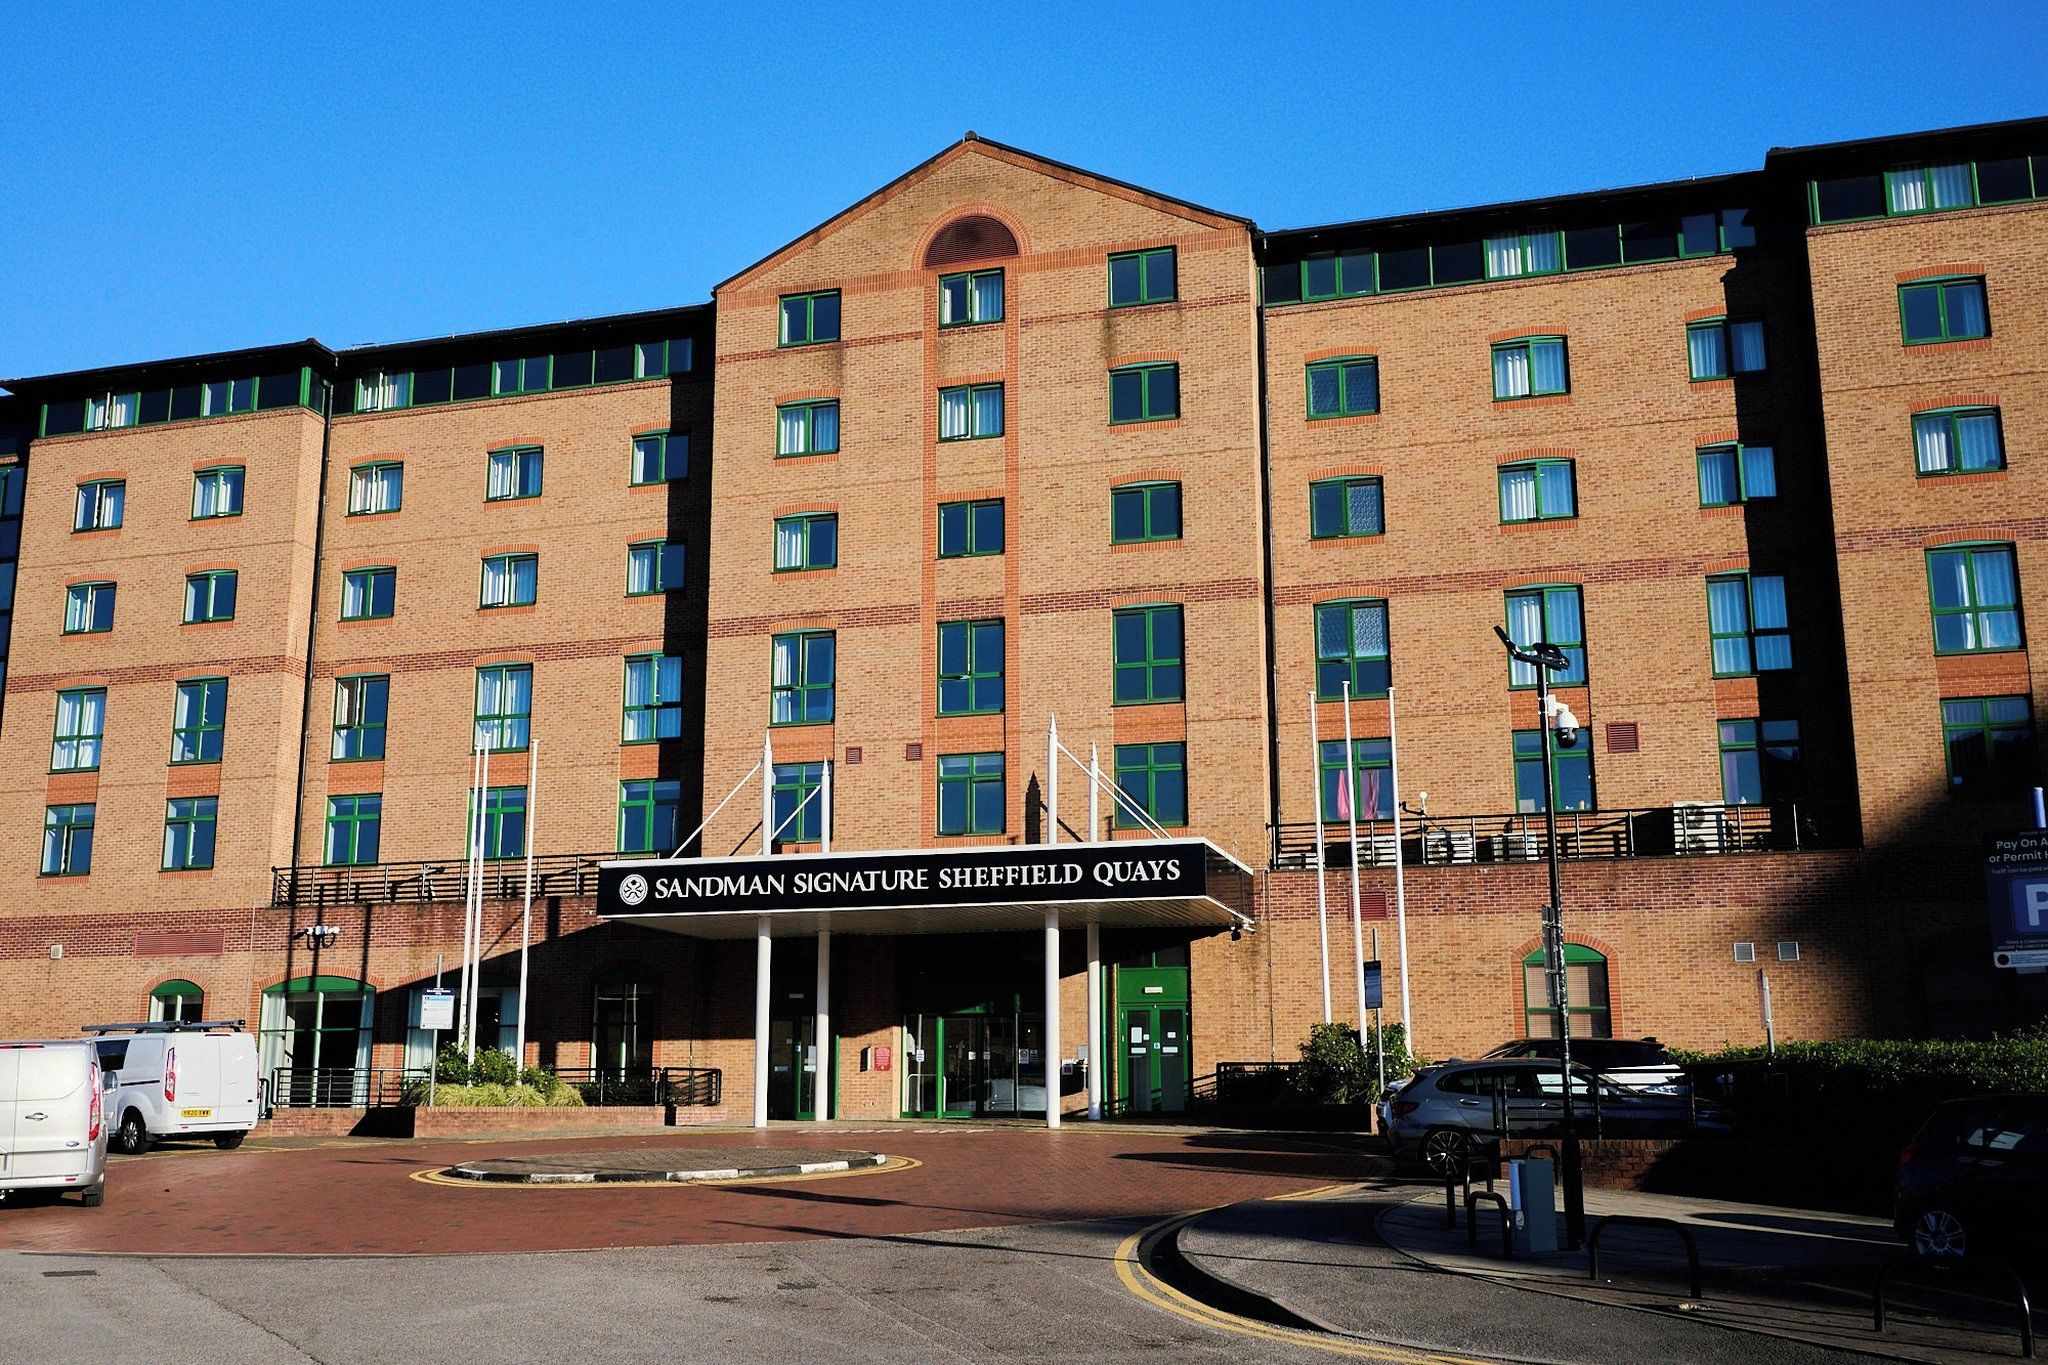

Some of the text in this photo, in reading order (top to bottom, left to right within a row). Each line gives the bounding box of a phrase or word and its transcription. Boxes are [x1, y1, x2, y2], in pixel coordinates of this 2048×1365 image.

[1996, 840, 2018, 851] Pay
[2020, 838, 2038, 848] On
[1989, 855, 2001, 863] or
[2003, 850, 2042, 862] Permit
[655, 859, 1181, 899] SANDMAN SIGNATURE SHEFFIELD QUAYS
